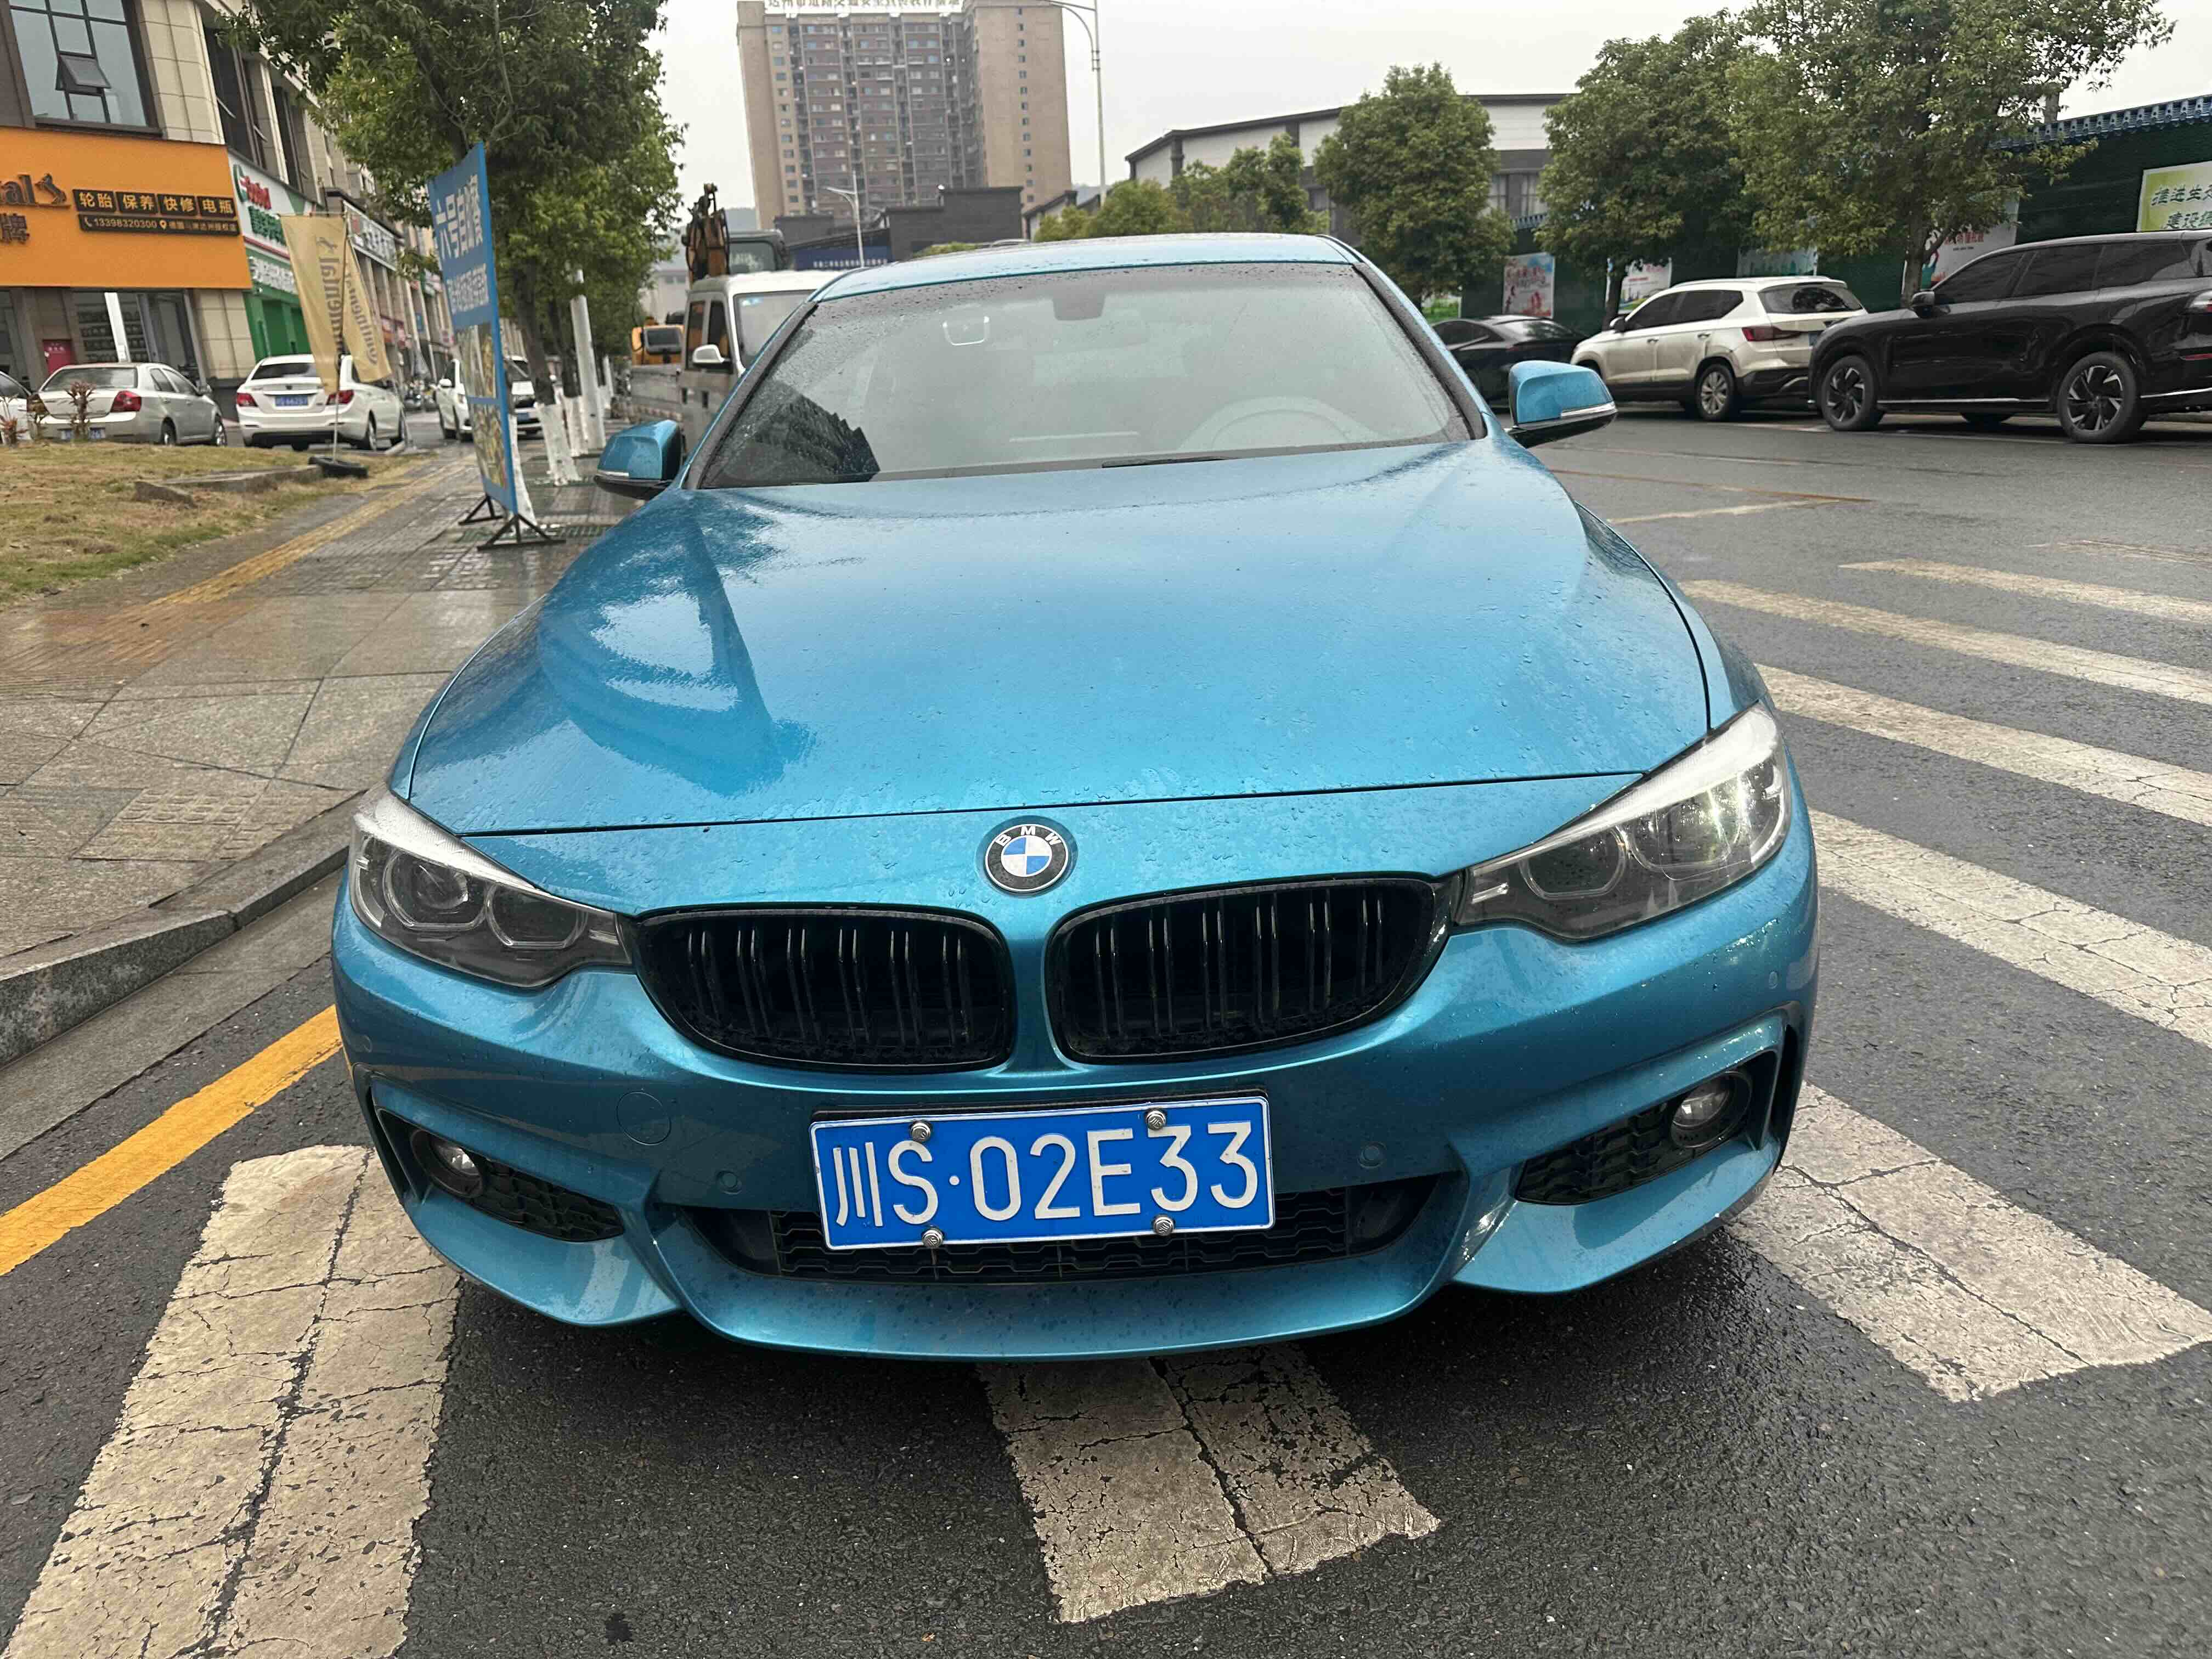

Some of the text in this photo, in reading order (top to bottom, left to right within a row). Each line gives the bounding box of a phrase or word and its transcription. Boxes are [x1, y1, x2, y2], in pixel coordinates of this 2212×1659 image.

[0, 174, 35, 206] al
[79, 193, 234, 214] 轮胎 保养 快修 电瓶
[995, 826, 1062, 847] BMW
[833, 1121, 1258, 1227] 川S·02E33
